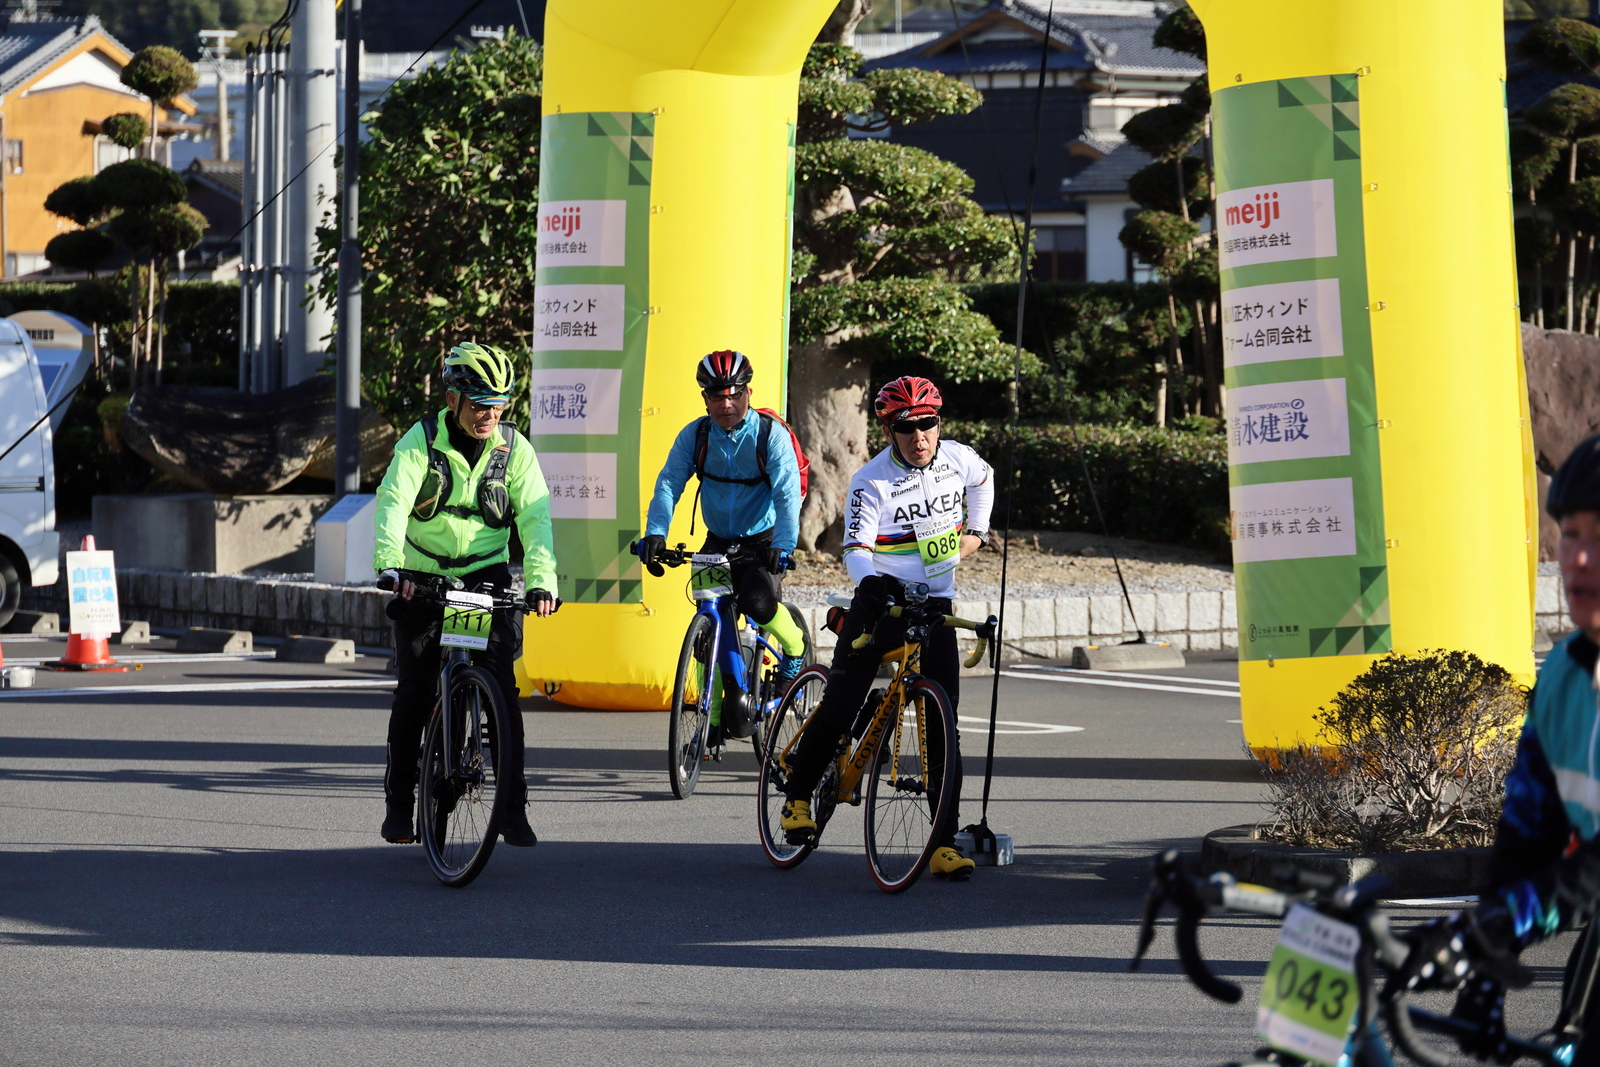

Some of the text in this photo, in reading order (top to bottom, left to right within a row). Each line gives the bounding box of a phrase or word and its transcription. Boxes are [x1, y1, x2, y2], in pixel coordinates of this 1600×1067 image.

[1225, 191, 1280, 229] meiji
[1254, 402, 1291, 411] CORPORATION
[1231, 411, 1310, 447] 清水建設
[935, 463, 950, 474] UCI
[548, 484, 606, 498] 株式会社
[891, 482, 920, 498] Bianchi
[849, 488, 864, 539] ARKEA
[894, 491, 962, 524] ARKEA
[917, 529, 936, 539] CYCLE
[927, 533, 957, 559] 086
[697, 570, 727, 586] 112
[452, 612, 483, 632] 111
[855, 692, 901, 770] COLNAGO
[893, 703, 906, 769] COLNAGO
[1276, 959, 1350, 1021] 043
